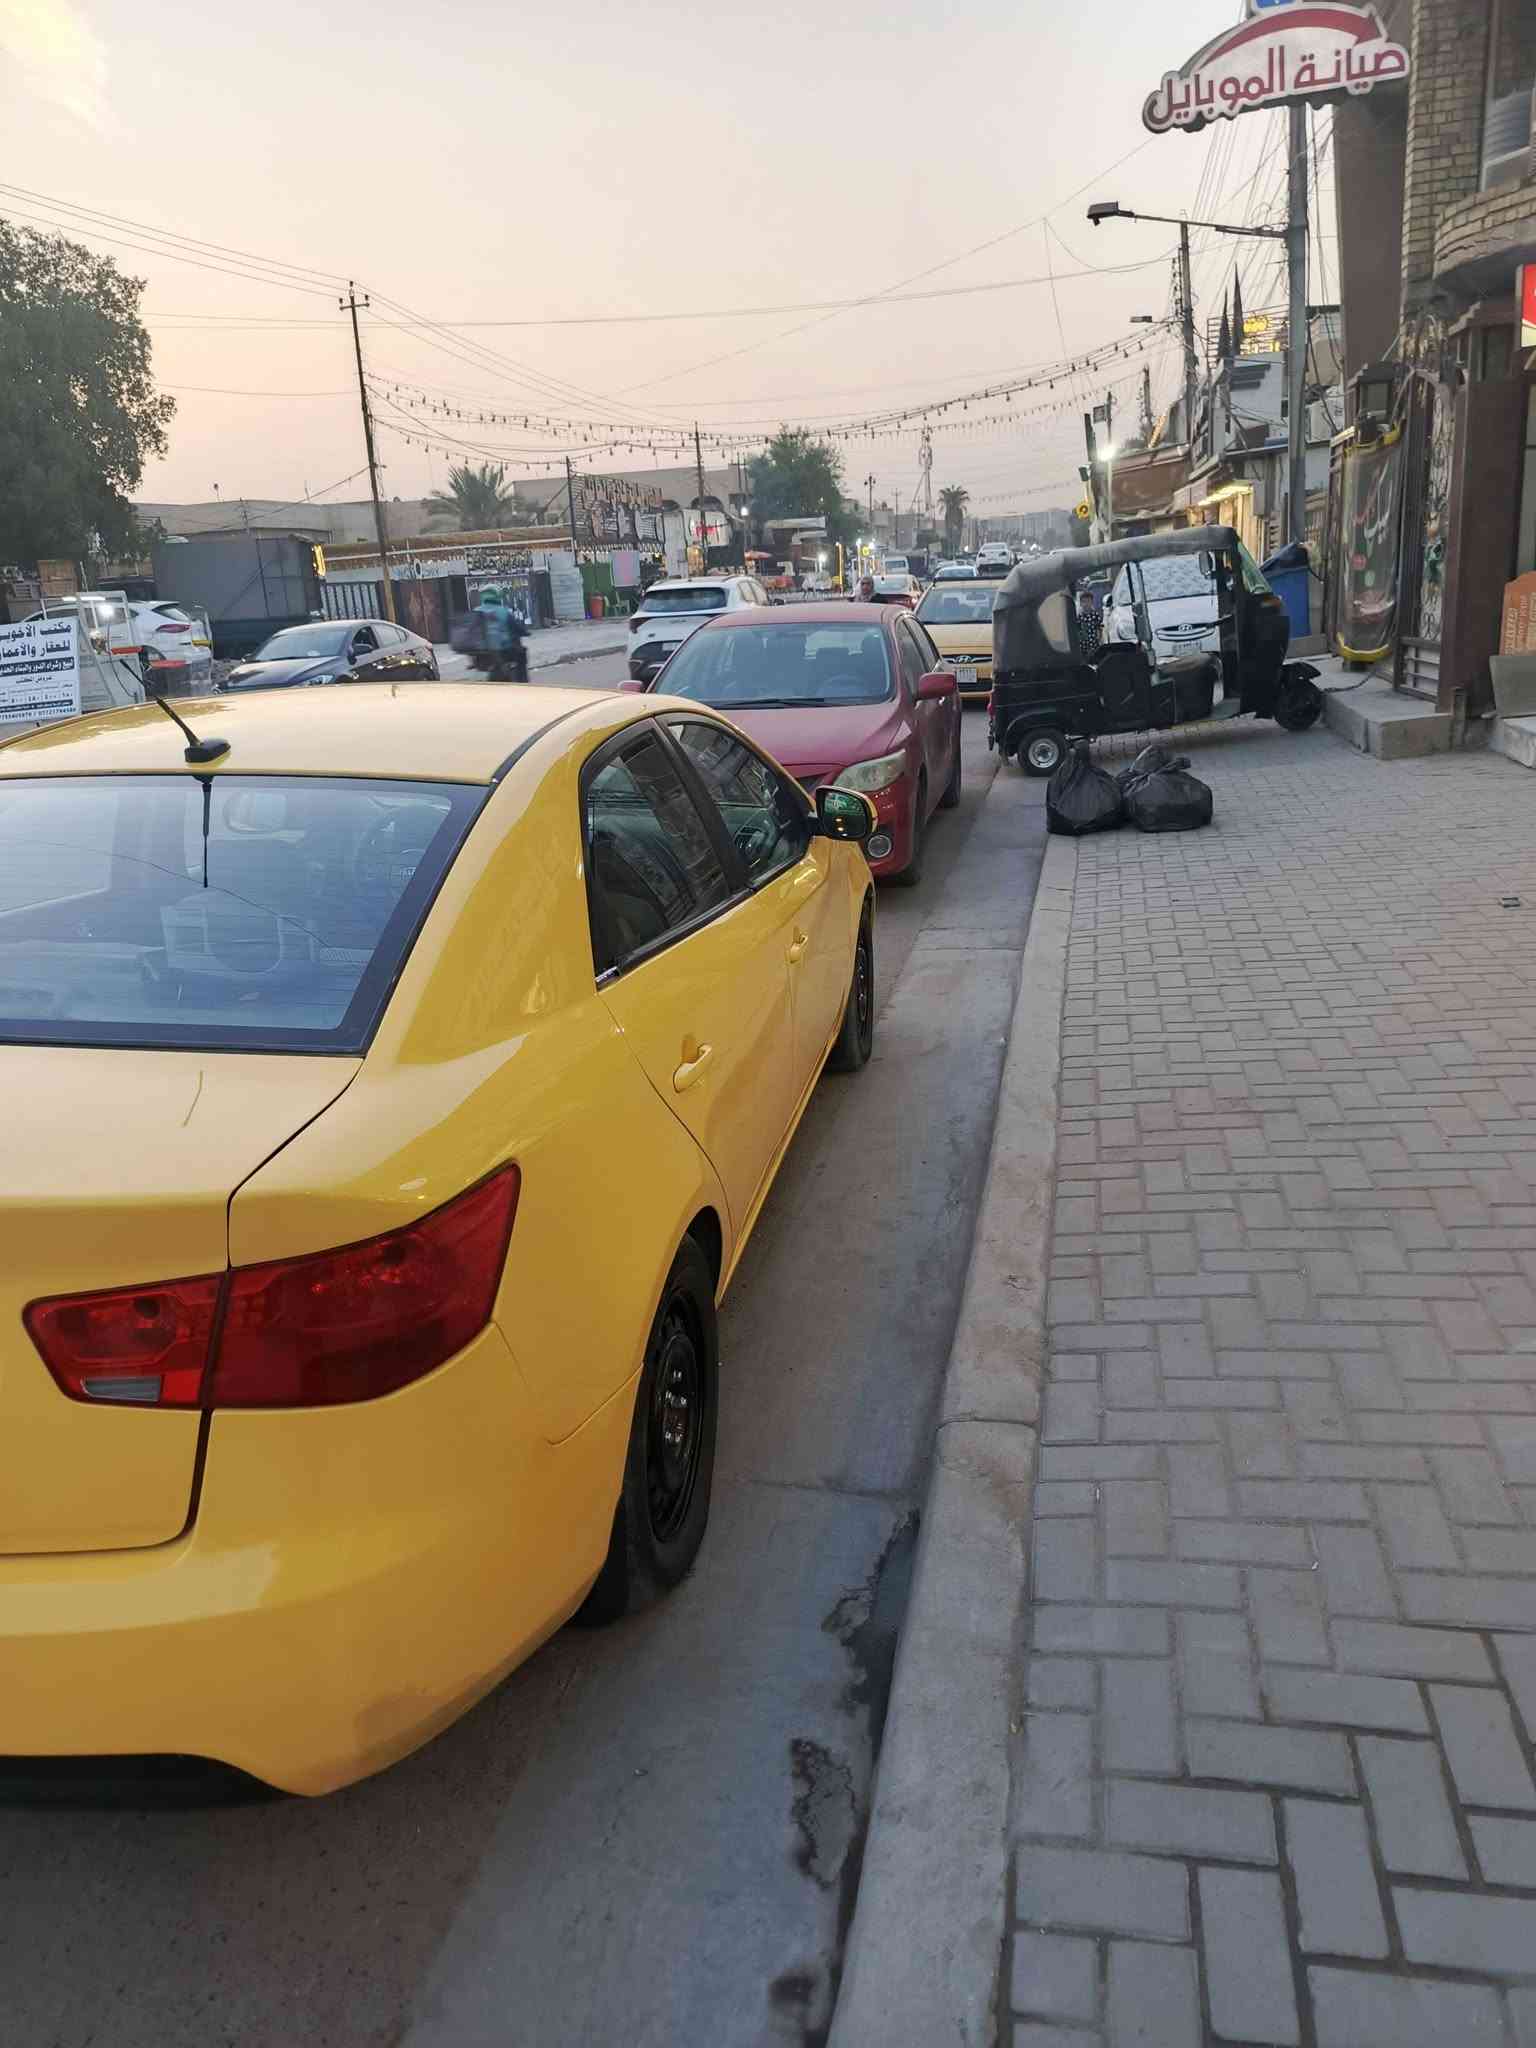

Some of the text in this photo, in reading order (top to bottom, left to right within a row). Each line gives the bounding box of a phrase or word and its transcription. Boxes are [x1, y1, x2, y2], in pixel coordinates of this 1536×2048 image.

[1146, 45, 1405, 125] صيانة الموبايل
[0, 621, 72, 643] مكتب الأخوي
[40, 639, 71, 657] للعقار
